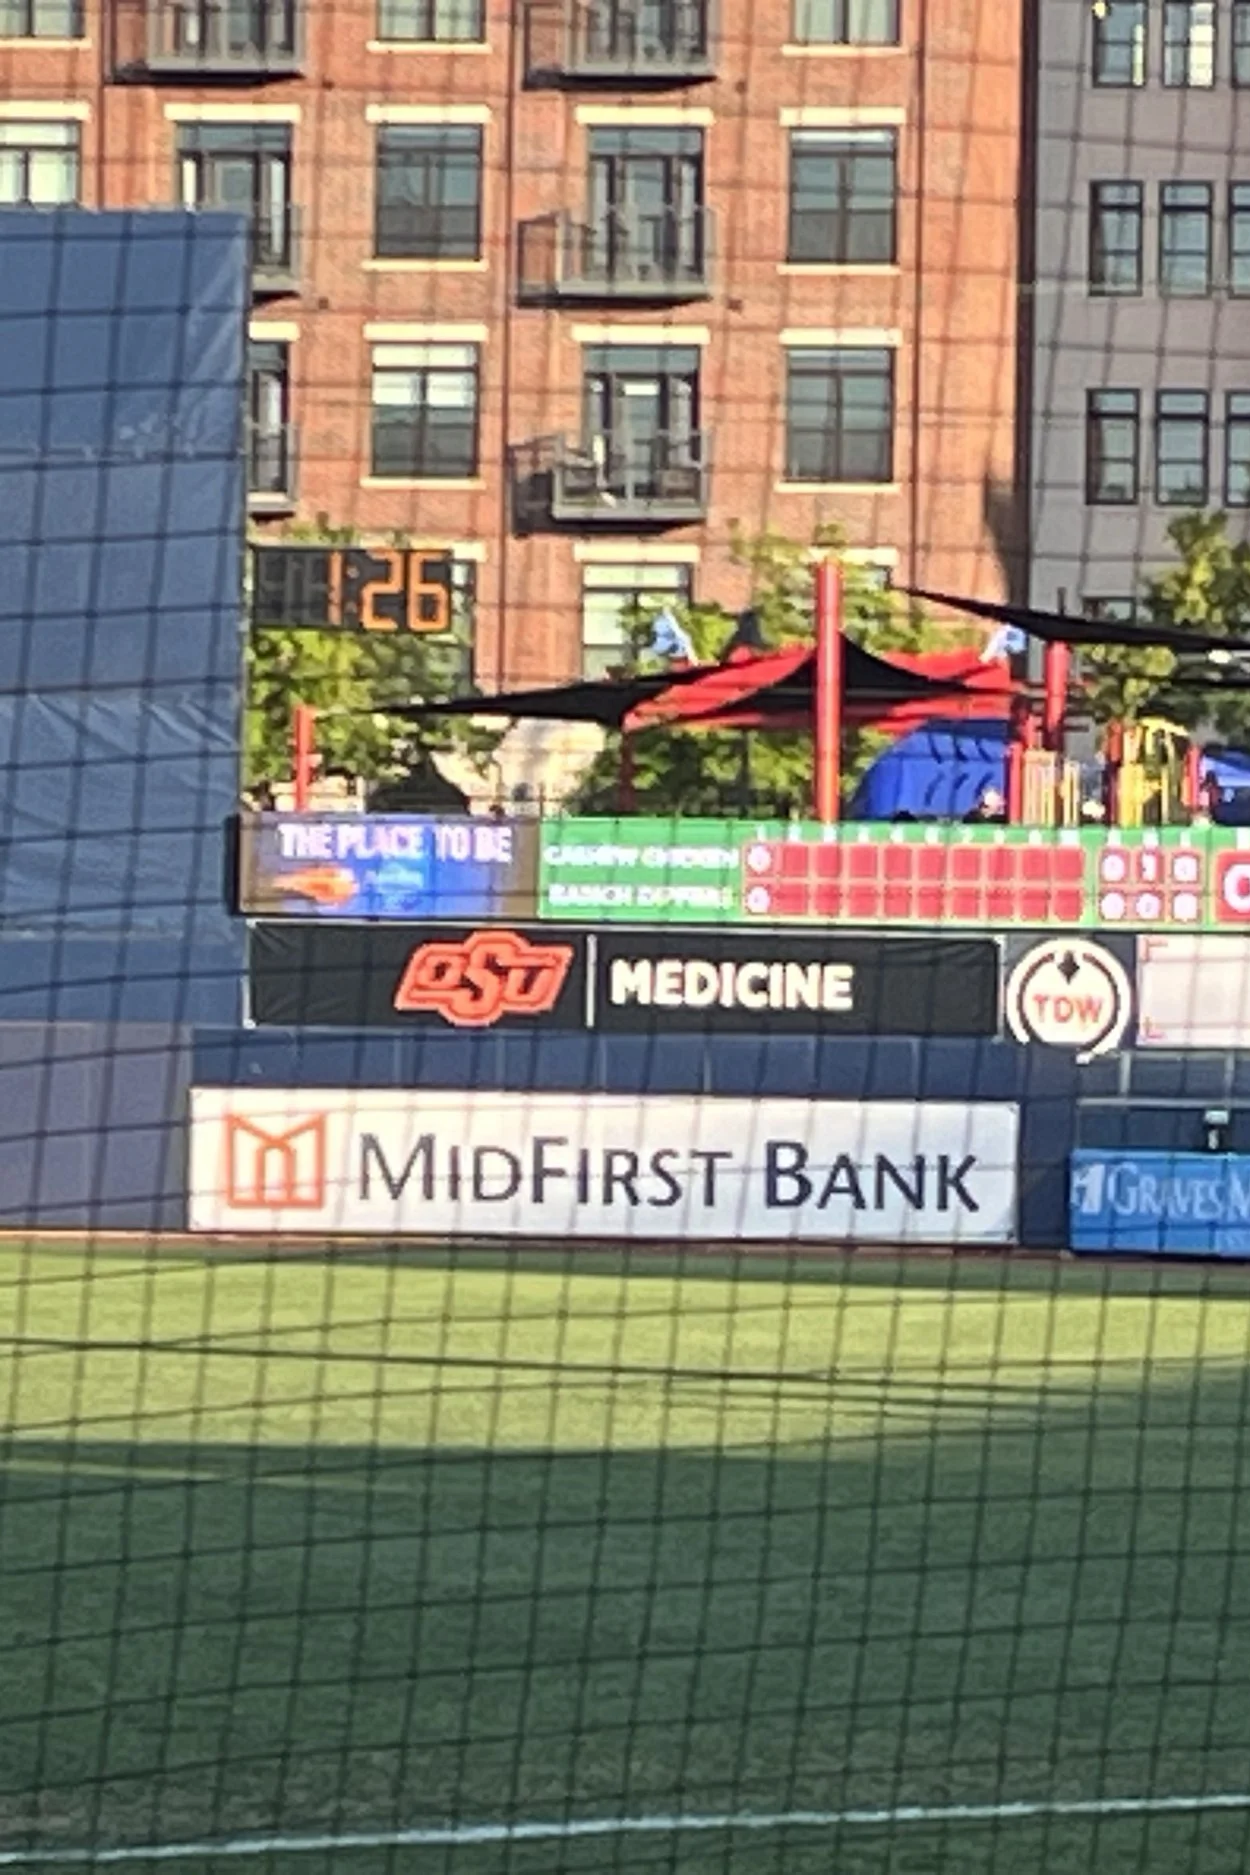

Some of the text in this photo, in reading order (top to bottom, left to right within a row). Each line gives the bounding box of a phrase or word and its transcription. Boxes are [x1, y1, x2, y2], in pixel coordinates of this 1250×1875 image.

[327, 547, 450, 631] 1:26
[278, 824, 513, 863] THE PLACE TO BE
[395, 931, 854, 1026] OSU MEDICINE
[1033, 995, 1104, 1024] TDW
